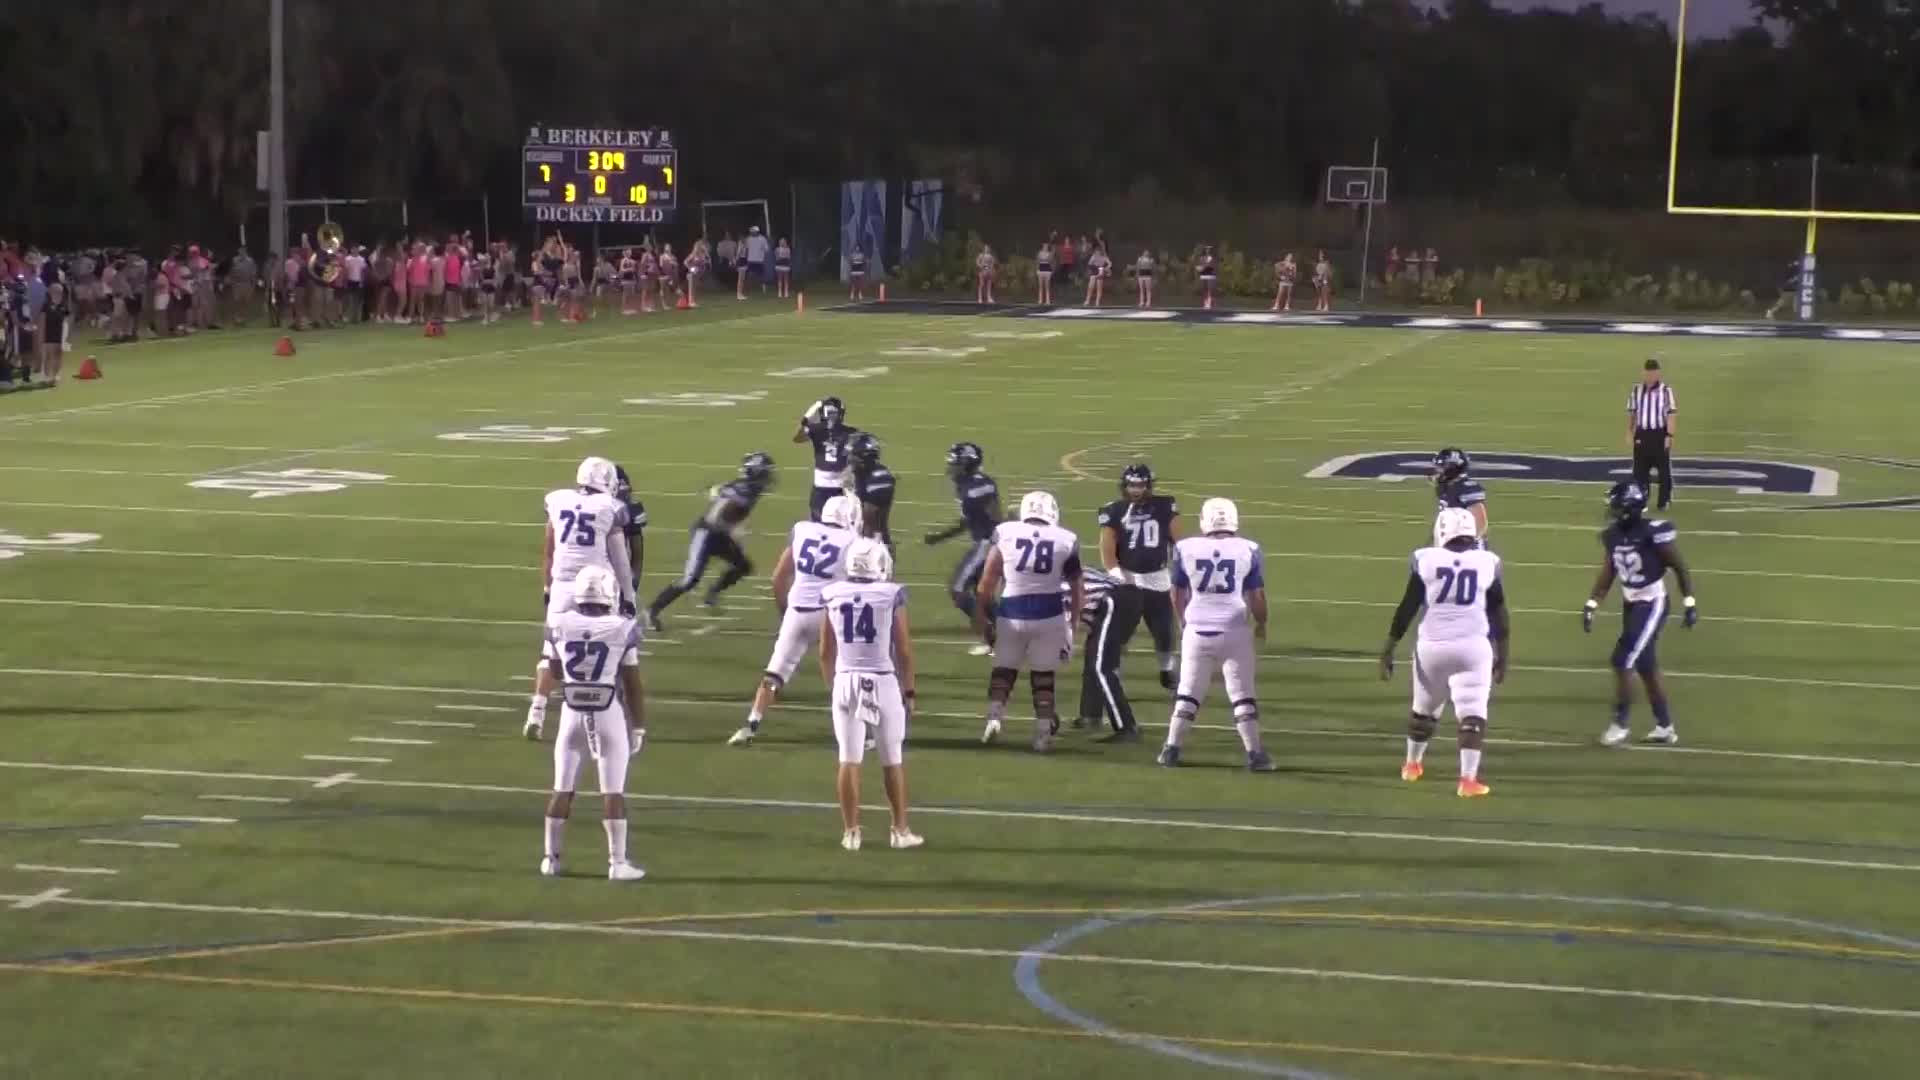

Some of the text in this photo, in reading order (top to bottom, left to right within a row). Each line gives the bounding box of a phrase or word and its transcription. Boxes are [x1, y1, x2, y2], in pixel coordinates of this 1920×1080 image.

[548, 129, 652, 145] BERKELEY
[540, 165, 550, 182] 7
[594, 175, 606, 194] 0
[662, 167, 672, 185] 7
[565, 183, 576, 202] 3
[630, 184, 647, 204] 10
[536, 206, 663, 222] DICKEY FIELD
[559, 510, 595, 546] 75
[1126, 520, 1159, 549] 70
[797, 538, 841, 579] 52
[1015, 539, 1053, 573] 78
[1196, 559, 1236, 593] 73
[1436, 567, 1478, 605] 70
[840, 602, 877, 643] 14
[565, 641, 609, 681] 27
